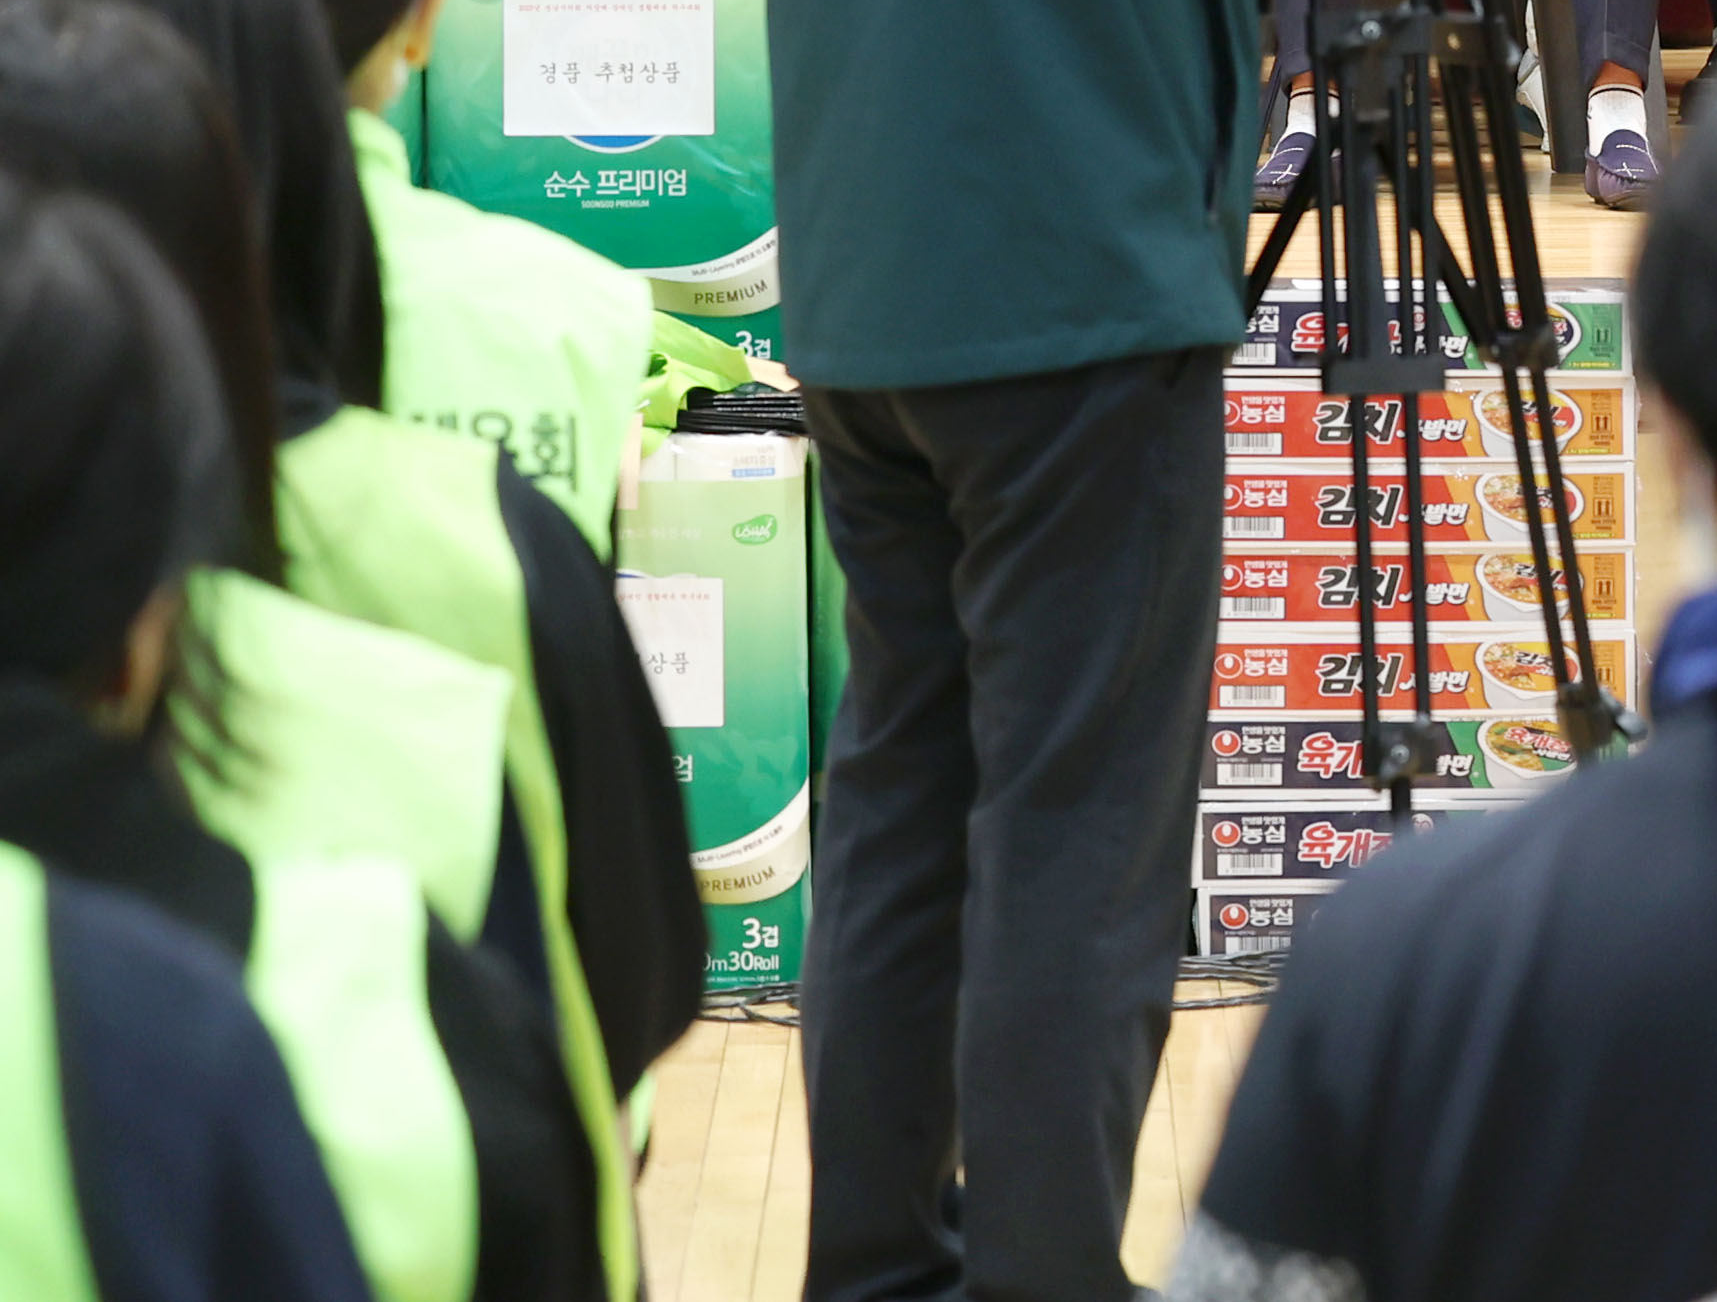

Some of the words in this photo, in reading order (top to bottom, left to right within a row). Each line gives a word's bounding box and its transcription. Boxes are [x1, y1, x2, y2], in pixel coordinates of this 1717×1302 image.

[540, 62, 581, 84] 경품
[595, 61, 681, 84] 추첨상품
[544, 170, 591, 198] 순수
[596, 168, 687, 196] 프리미엄
[694, 279, 768, 305] PREMIUM
[1241, 405, 1285, 424] 농심
[1243, 489, 1288, 507] 농심
[1243, 569, 1288, 588] 농심
[1244, 658, 1288, 676] 농심
[1242, 735, 1286, 753] 농심
[1298, 732, 1366, 779] 육개
[1242, 825, 1286, 844] 농심
[702, 865, 776, 892] PREMIUM
[1249, 908, 1294, 927] 농심
[742, 917, 779, 949] 3겹
